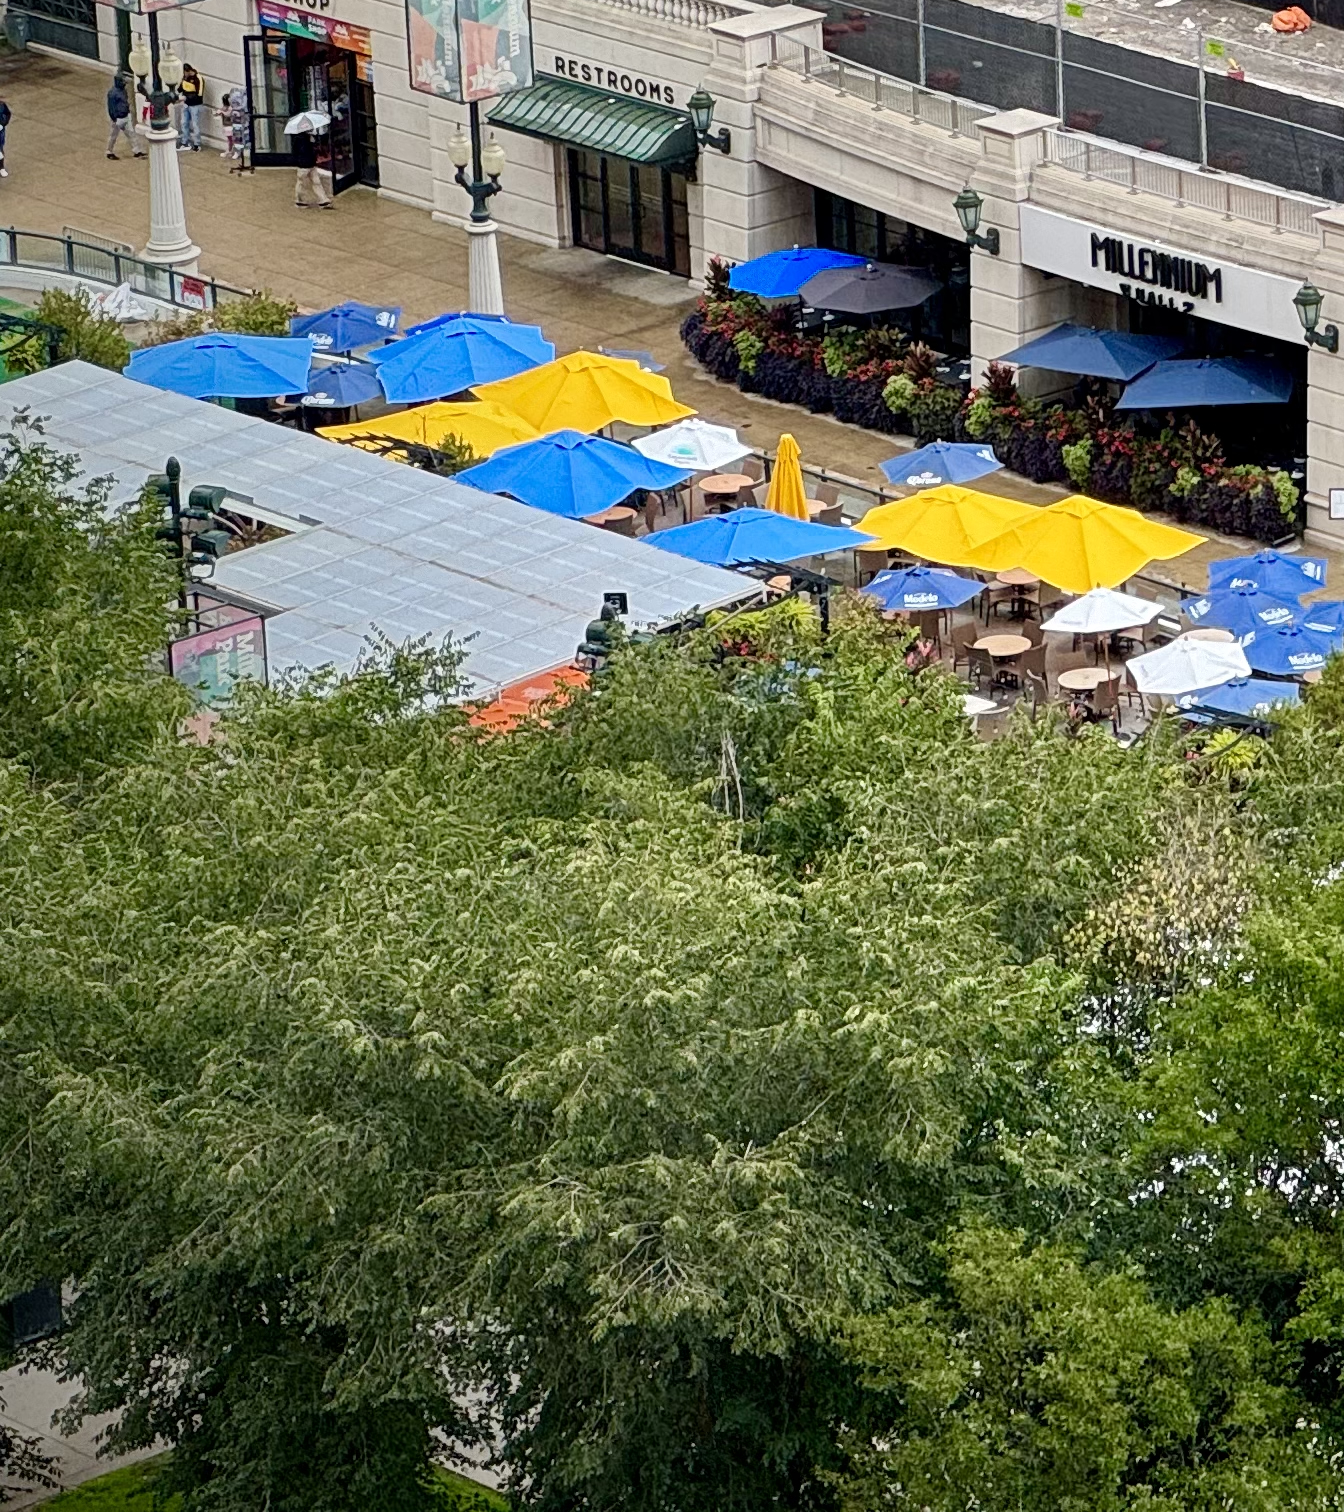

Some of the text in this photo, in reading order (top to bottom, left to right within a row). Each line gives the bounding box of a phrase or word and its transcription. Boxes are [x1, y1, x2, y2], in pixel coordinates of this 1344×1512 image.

[555, 56, 675, 104] RESTROOMS
[1091, 232, 1222, 303] MILLENNIUM
[904, 592, 938, 604] Modelo
